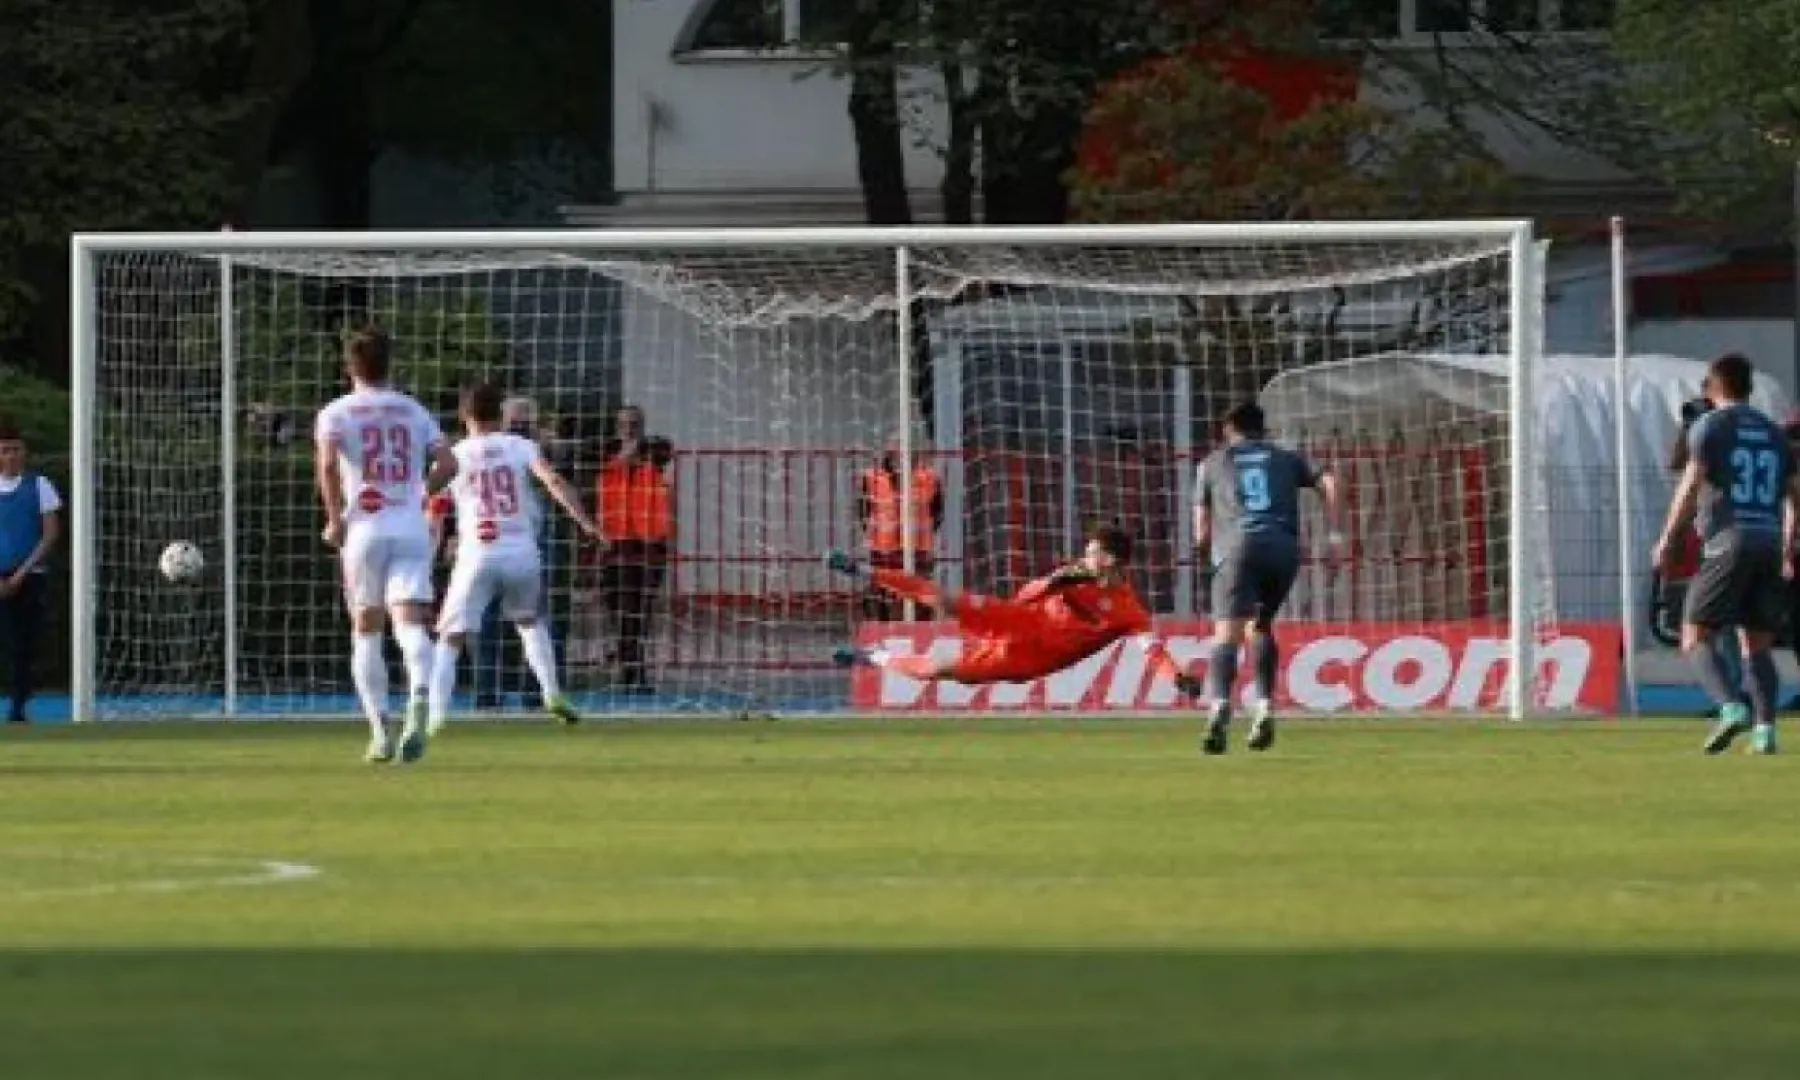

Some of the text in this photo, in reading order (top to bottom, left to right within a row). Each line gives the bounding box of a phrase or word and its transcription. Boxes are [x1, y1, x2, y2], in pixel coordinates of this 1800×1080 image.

[361, 424, 411, 483] 23
[1731, 447, 1779, 504] 33
[469, 465, 519, 516] 19
[1243, 468, 1271, 511] 9
